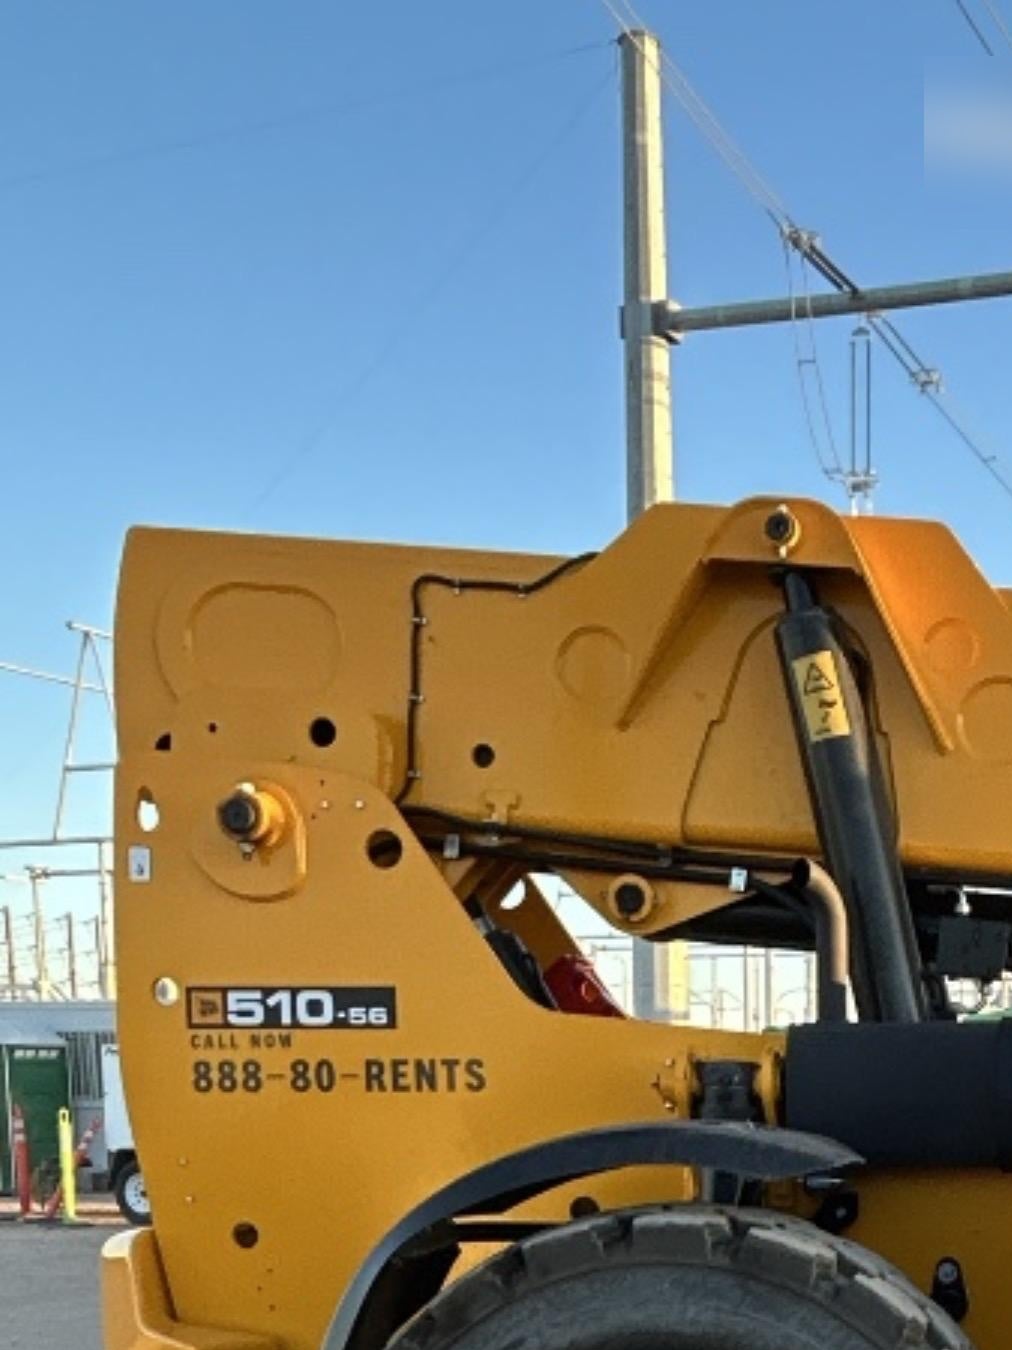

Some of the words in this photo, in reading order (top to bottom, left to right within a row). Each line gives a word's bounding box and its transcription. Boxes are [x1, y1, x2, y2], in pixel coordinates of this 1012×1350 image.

[190, 1033, 240, 1050] CALL
[249, 1033, 293, 1049] NOW
[192, 1058, 487, 1093] 888-80-RENTS
